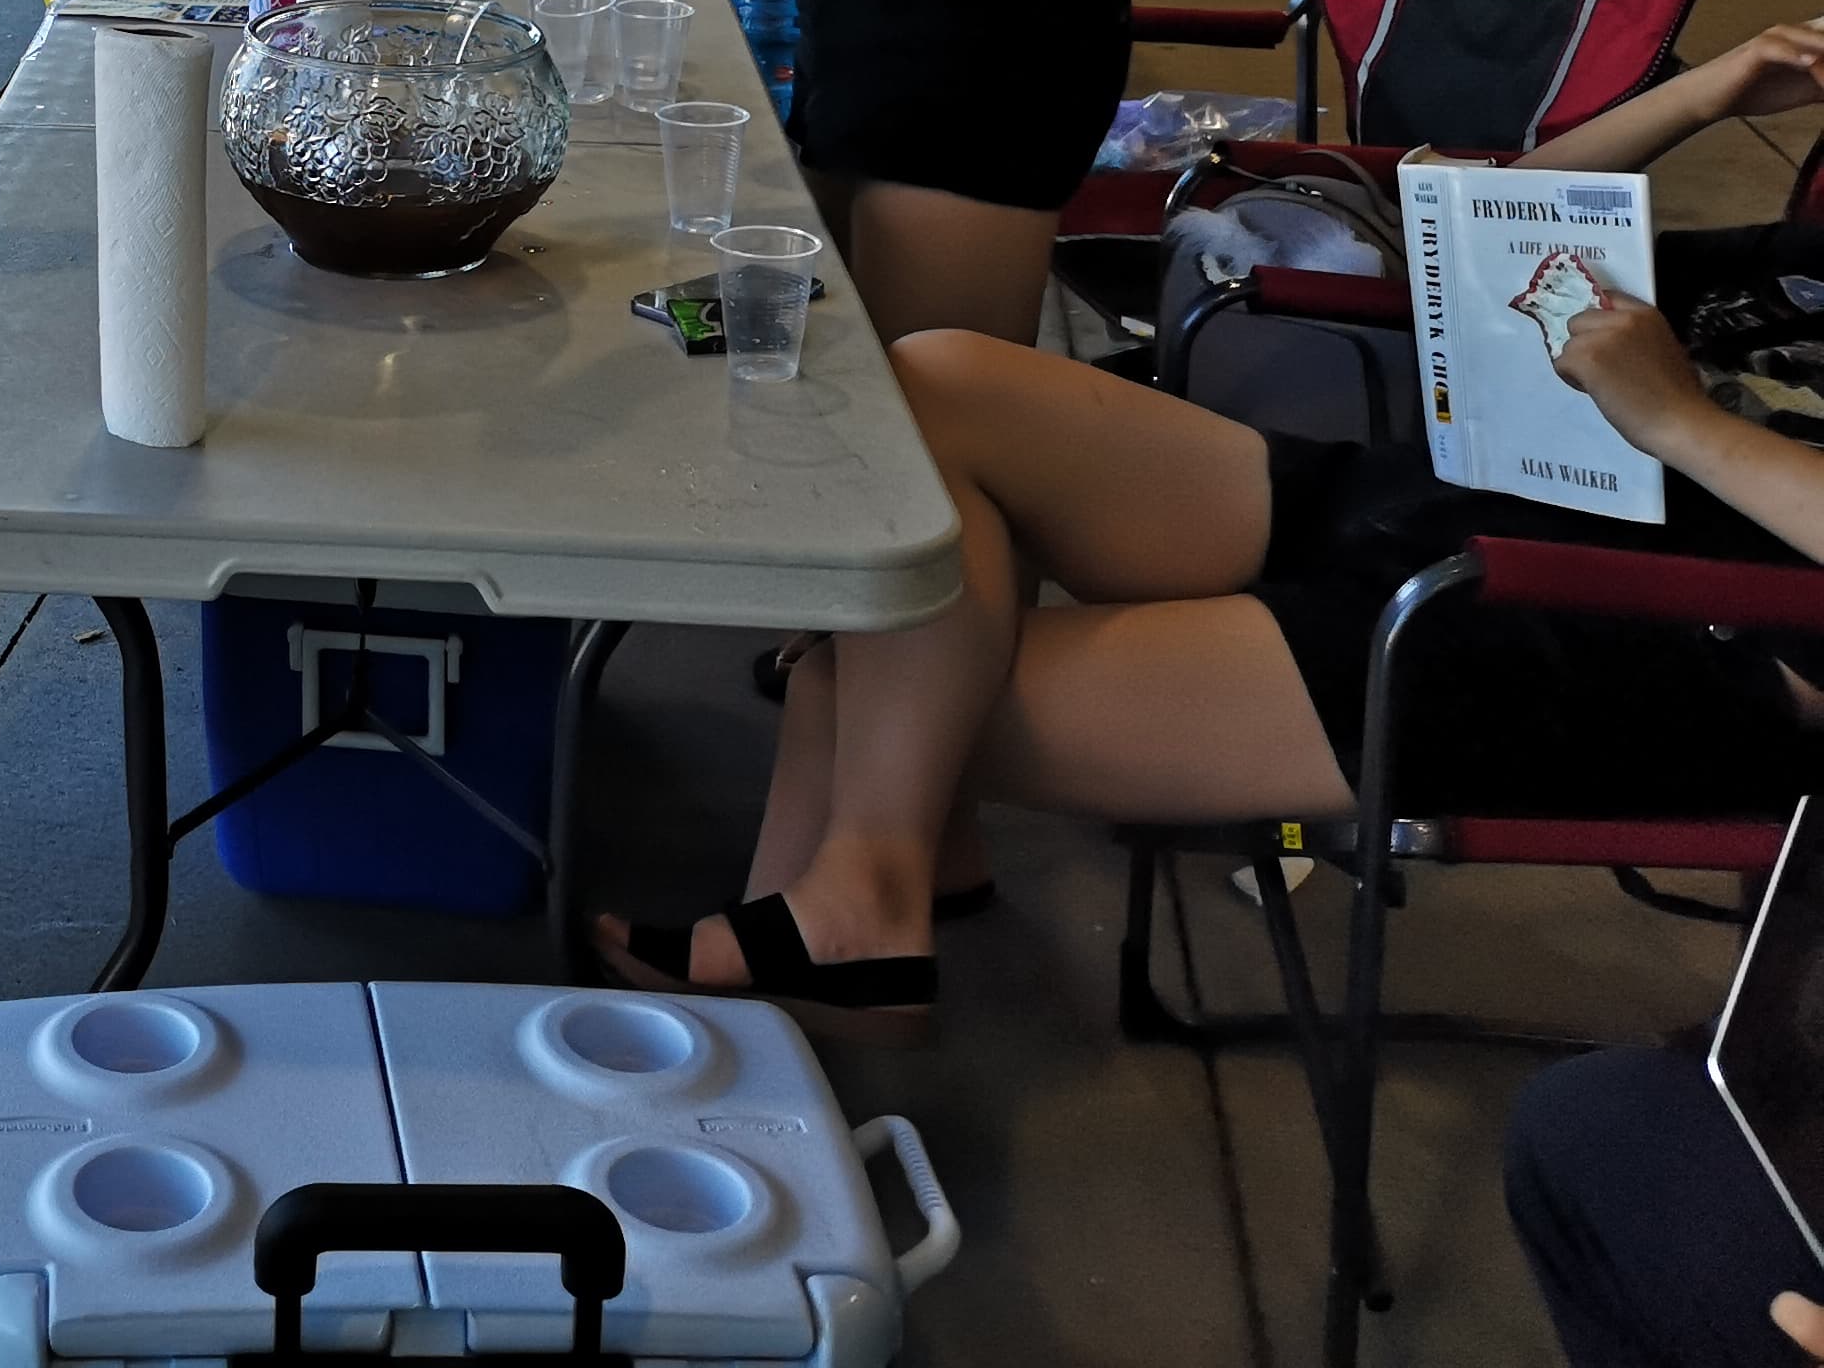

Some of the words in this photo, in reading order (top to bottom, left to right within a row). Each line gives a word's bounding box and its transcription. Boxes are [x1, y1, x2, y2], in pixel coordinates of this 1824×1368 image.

[1414, 193, 1438, 204] WALKER
[1471, 198, 1562, 223] FRYDERYK
[1507, 241, 1515, 255] A
[1519, 241, 1543, 256] LIFE
[1569, 244, 1607, 261] TIMES
[1421, 218, 1445, 341] FRYDERYK
[1520, 455, 1554, 481] ALAN
[1558, 463, 1619, 493] WALKER
